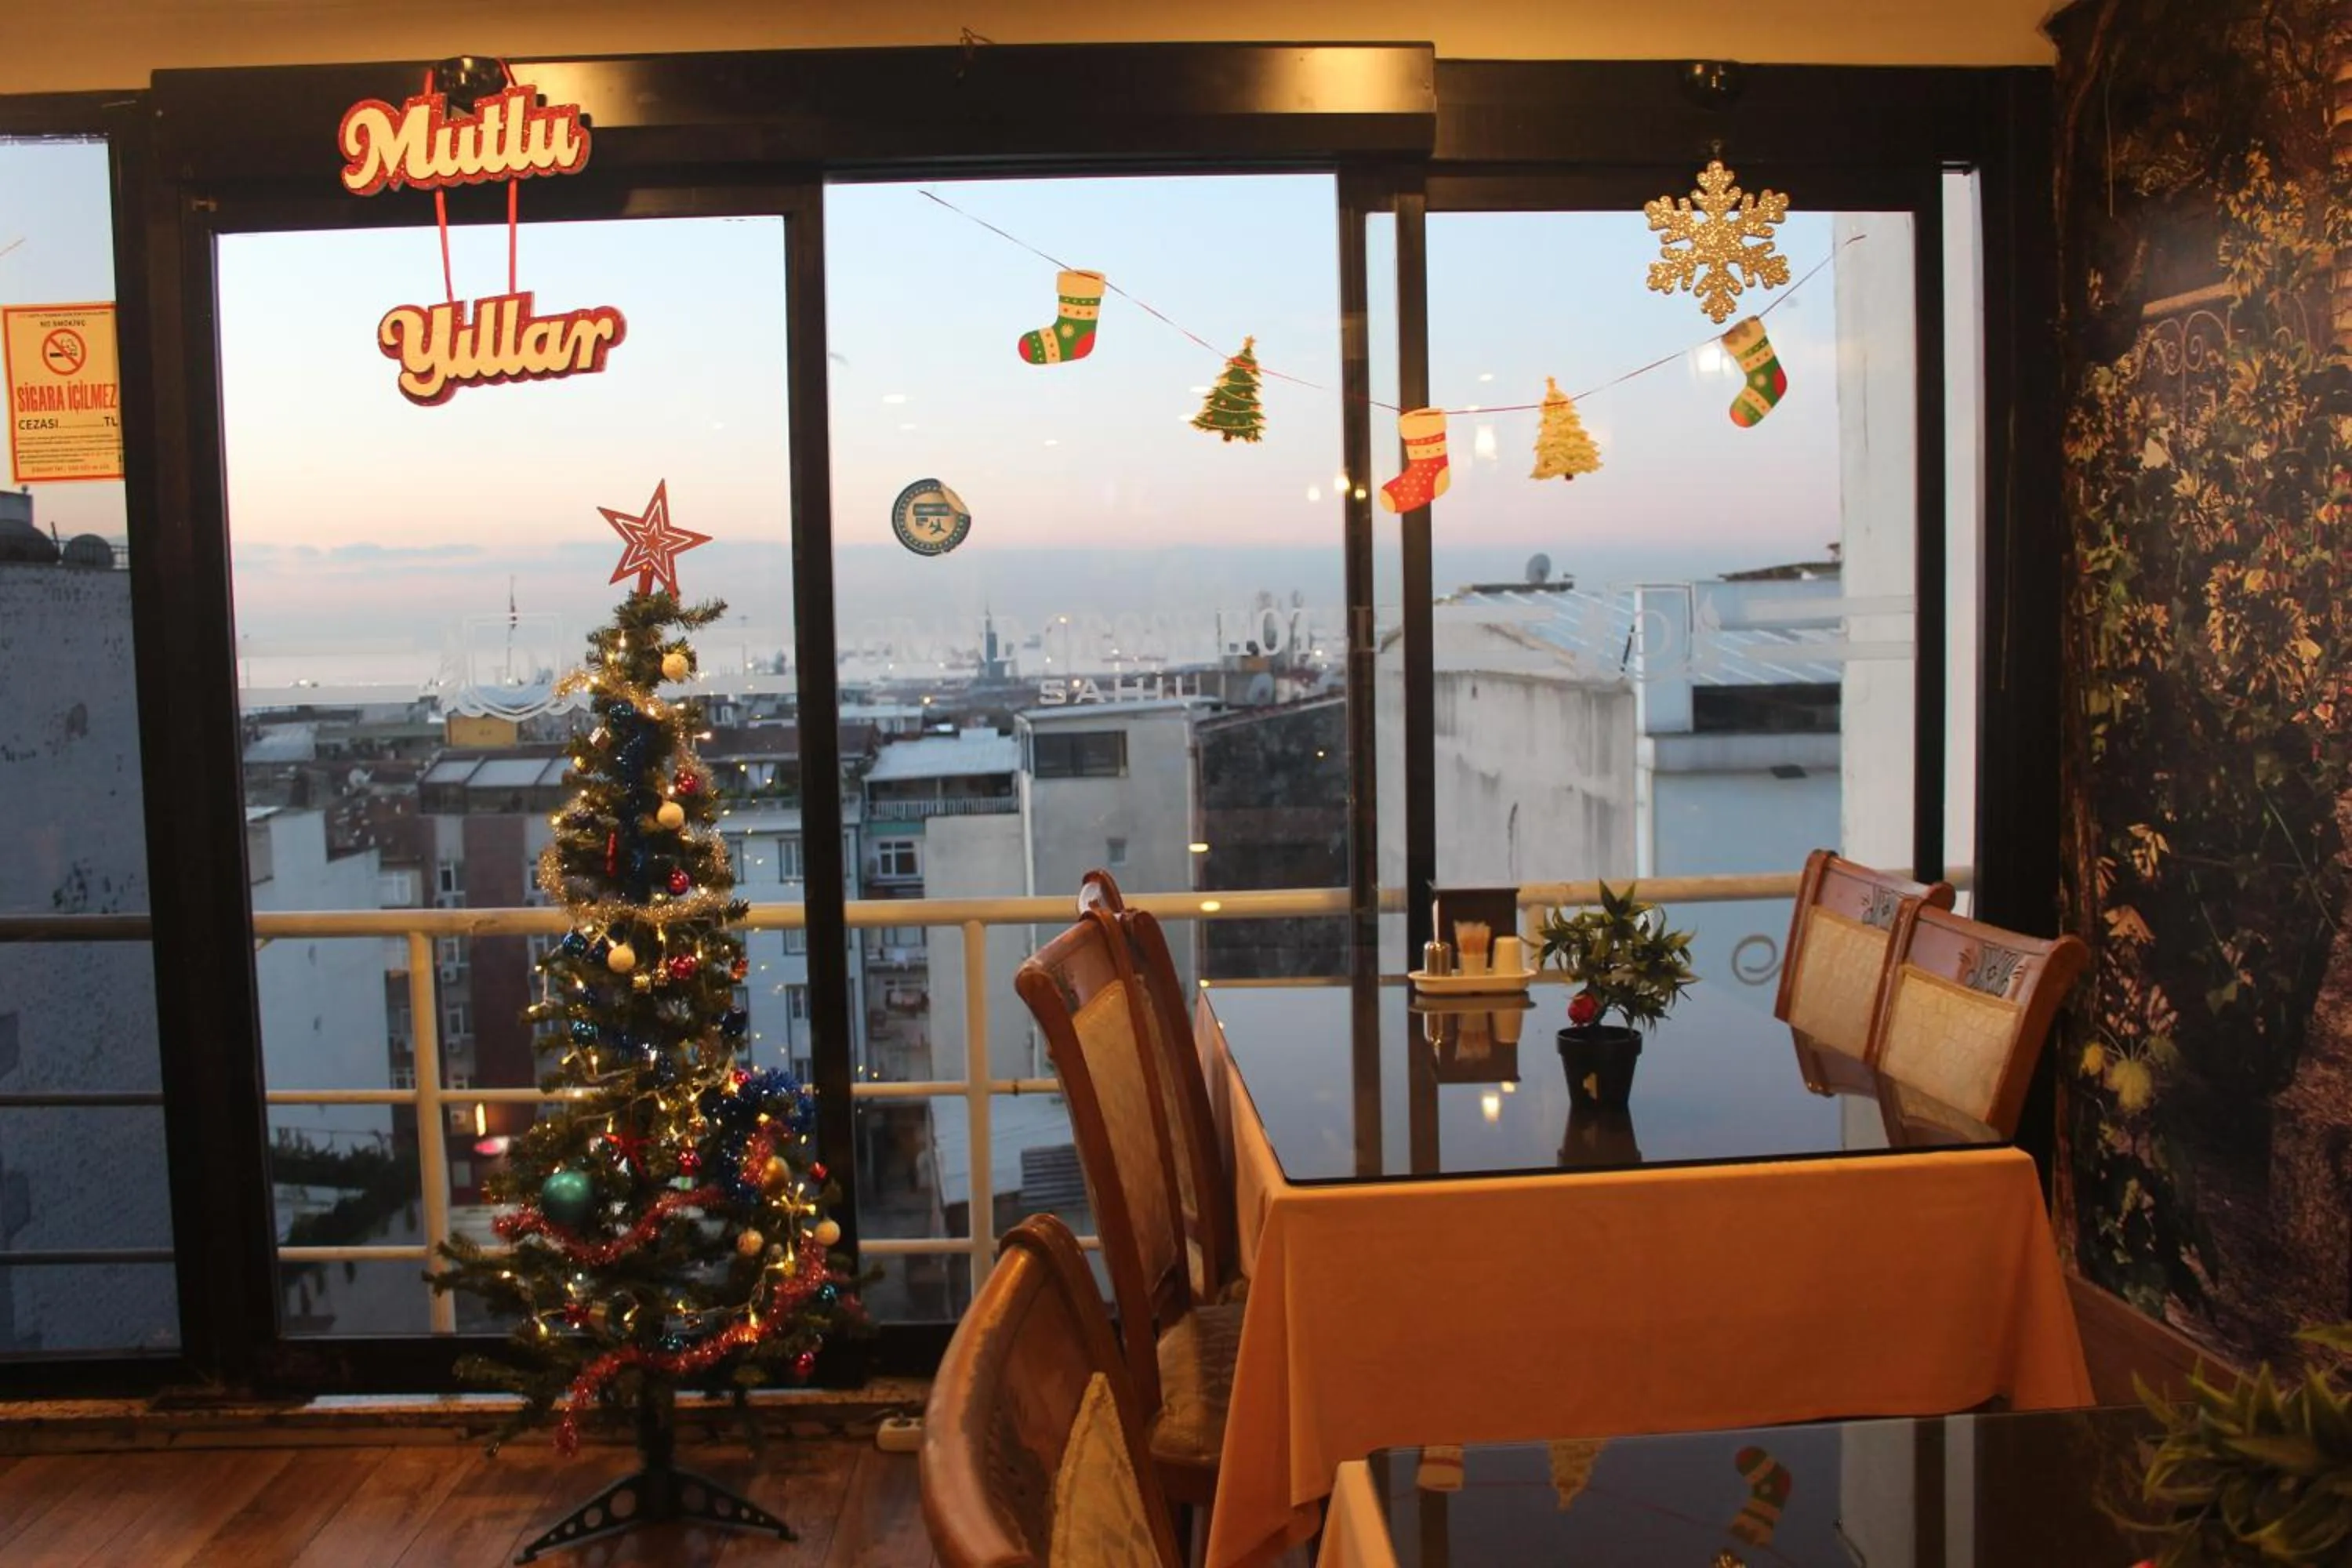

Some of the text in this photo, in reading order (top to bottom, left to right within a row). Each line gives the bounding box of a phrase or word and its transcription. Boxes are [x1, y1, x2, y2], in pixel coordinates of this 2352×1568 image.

[339, 85, 590, 194] Mutlu
[16, 379, 118, 414] SİGARA İÇİLMEZ
[378, 292, 625, 405] Yıllar
